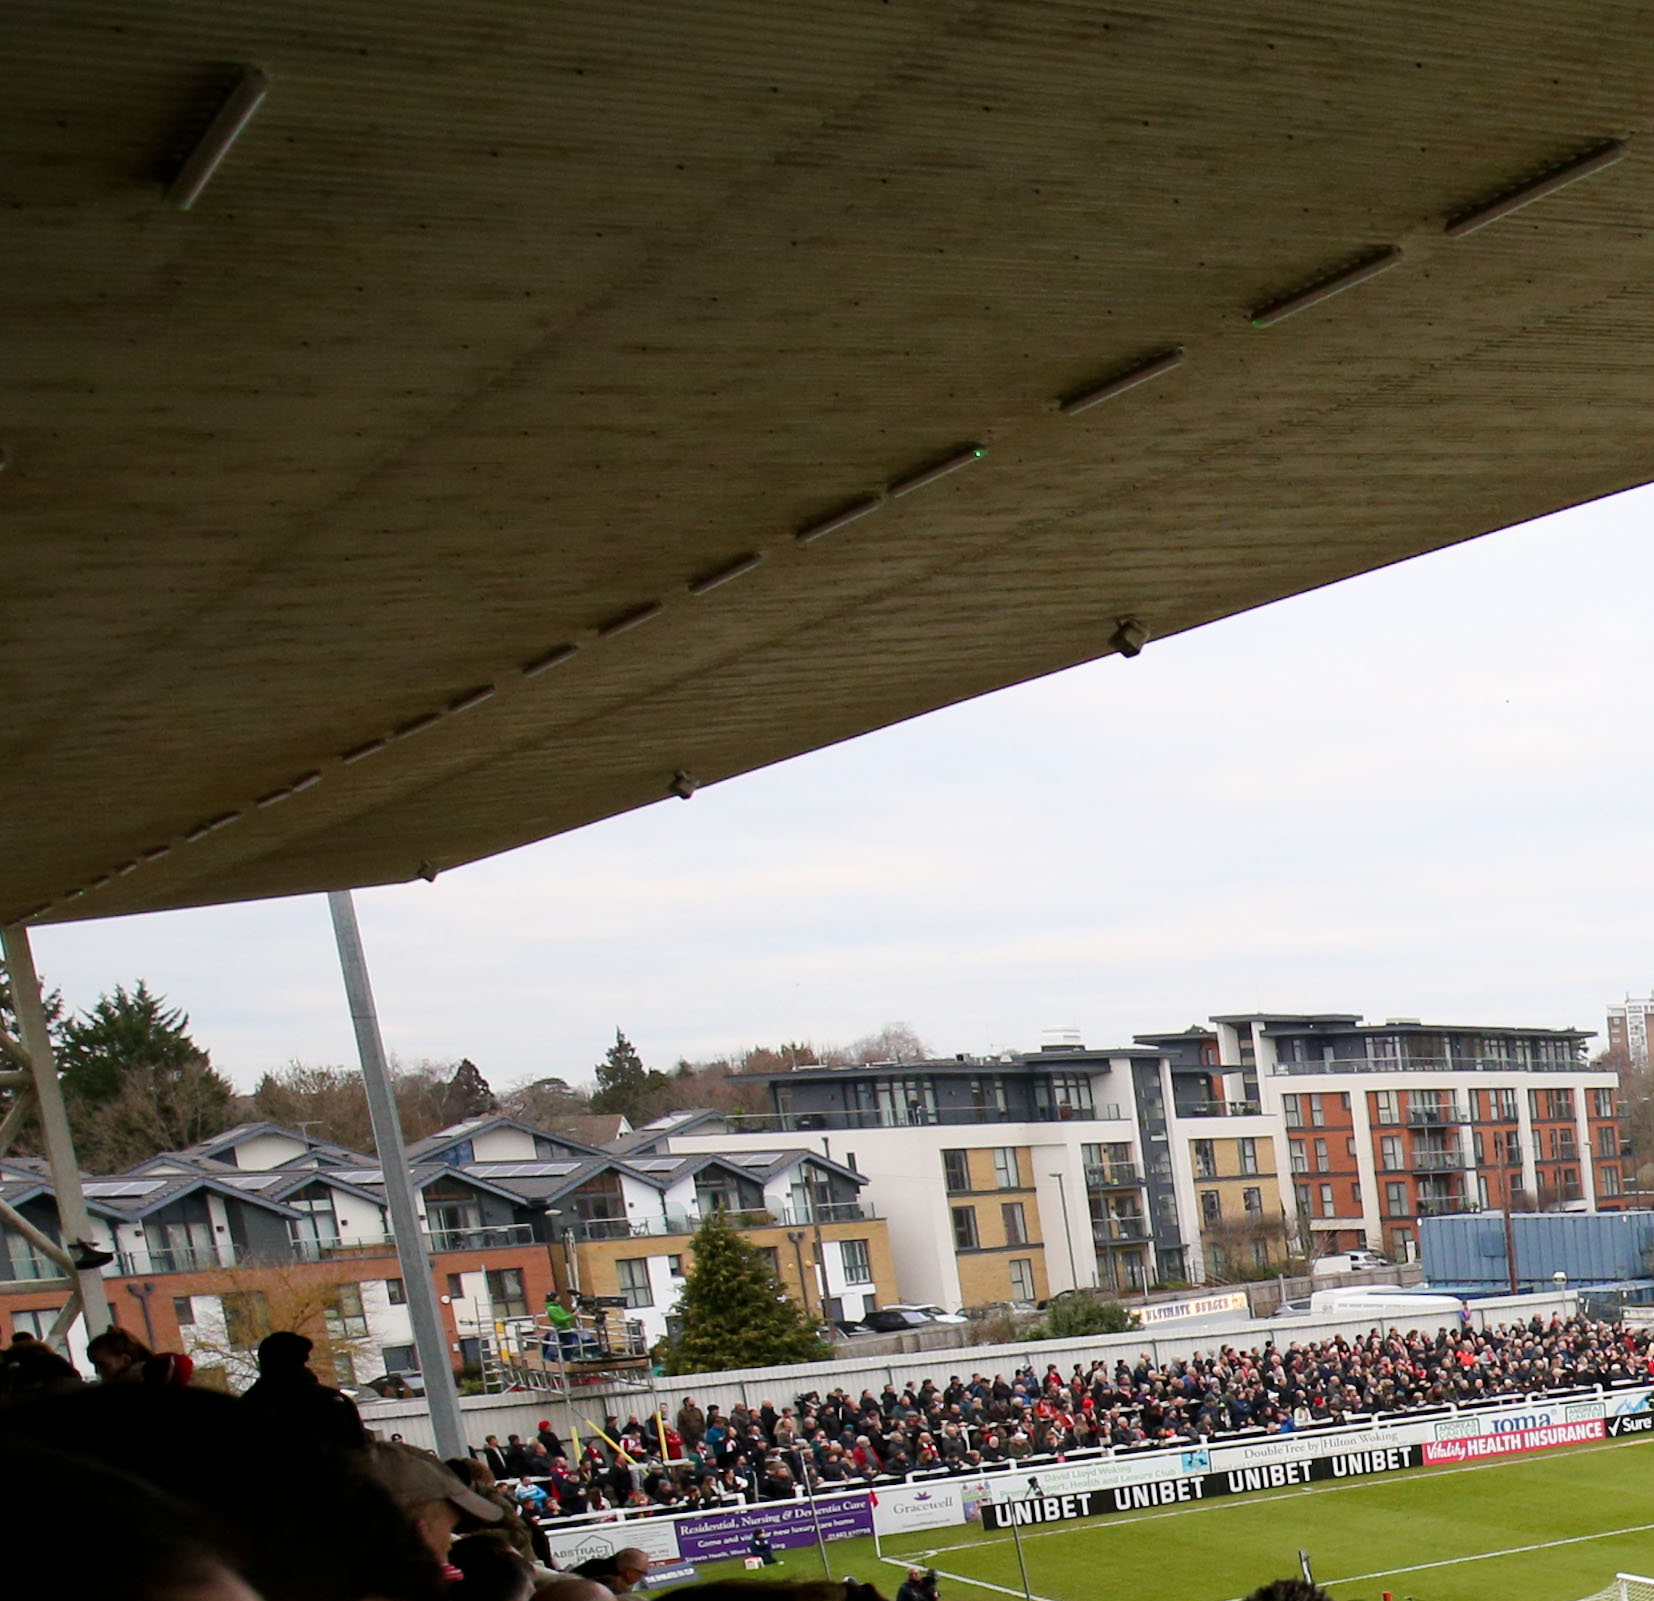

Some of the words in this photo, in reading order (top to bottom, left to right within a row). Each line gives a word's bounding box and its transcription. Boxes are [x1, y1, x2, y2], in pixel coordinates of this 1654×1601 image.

[1146, 1304, 1190, 1320] ULTIMATE
[1195, 1298, 1229, 1314] BURGER
[1622, 1417, 1652, 1432] Sure
[1244, 1442, 1304, 1459] DoubleTree
[1308, 1441, 1319, 1454] by
[1323, 1436, 1356, 1448] Hilton
[1360, 1431, 1398, 1448] Woking
[1427, 1440, 1466, 1461] Vitality
[1467, 1436, 1521, 1456] HEALTH
[1525, 1422, 1603, 1448] INSURANCE
[1044, 1471, 1070, 1482] David
[1072, 1468, 1096, 1480] Lloyd
[1099, 1465, 1132, 1477] Woking
[1102, 1476, 1119, 1486] and
[1155, 1468, 1176, 1478] Club
[995, 1493, 1092, 1528] UNIBET
[1114, 1476, 1205, 1512] UNIBET
[1228, 1460, 1313, 1493] UNIBET
[1332, 1446, 1412, 1477] UNIBET
[894, 1496, 952, 1514] Gracewell
[680, 1518, 739, 1536] Residential,
[741, 1512, 780, 1527] Nursing
[782, 1510, 792, 1520] &
[843, 1500, 866, 1510] Care
[834, 1518, 855, 1527] home
[724, 1535, 739, 1544] and
[553, 1545, 609, 1558] ABSTRACT
